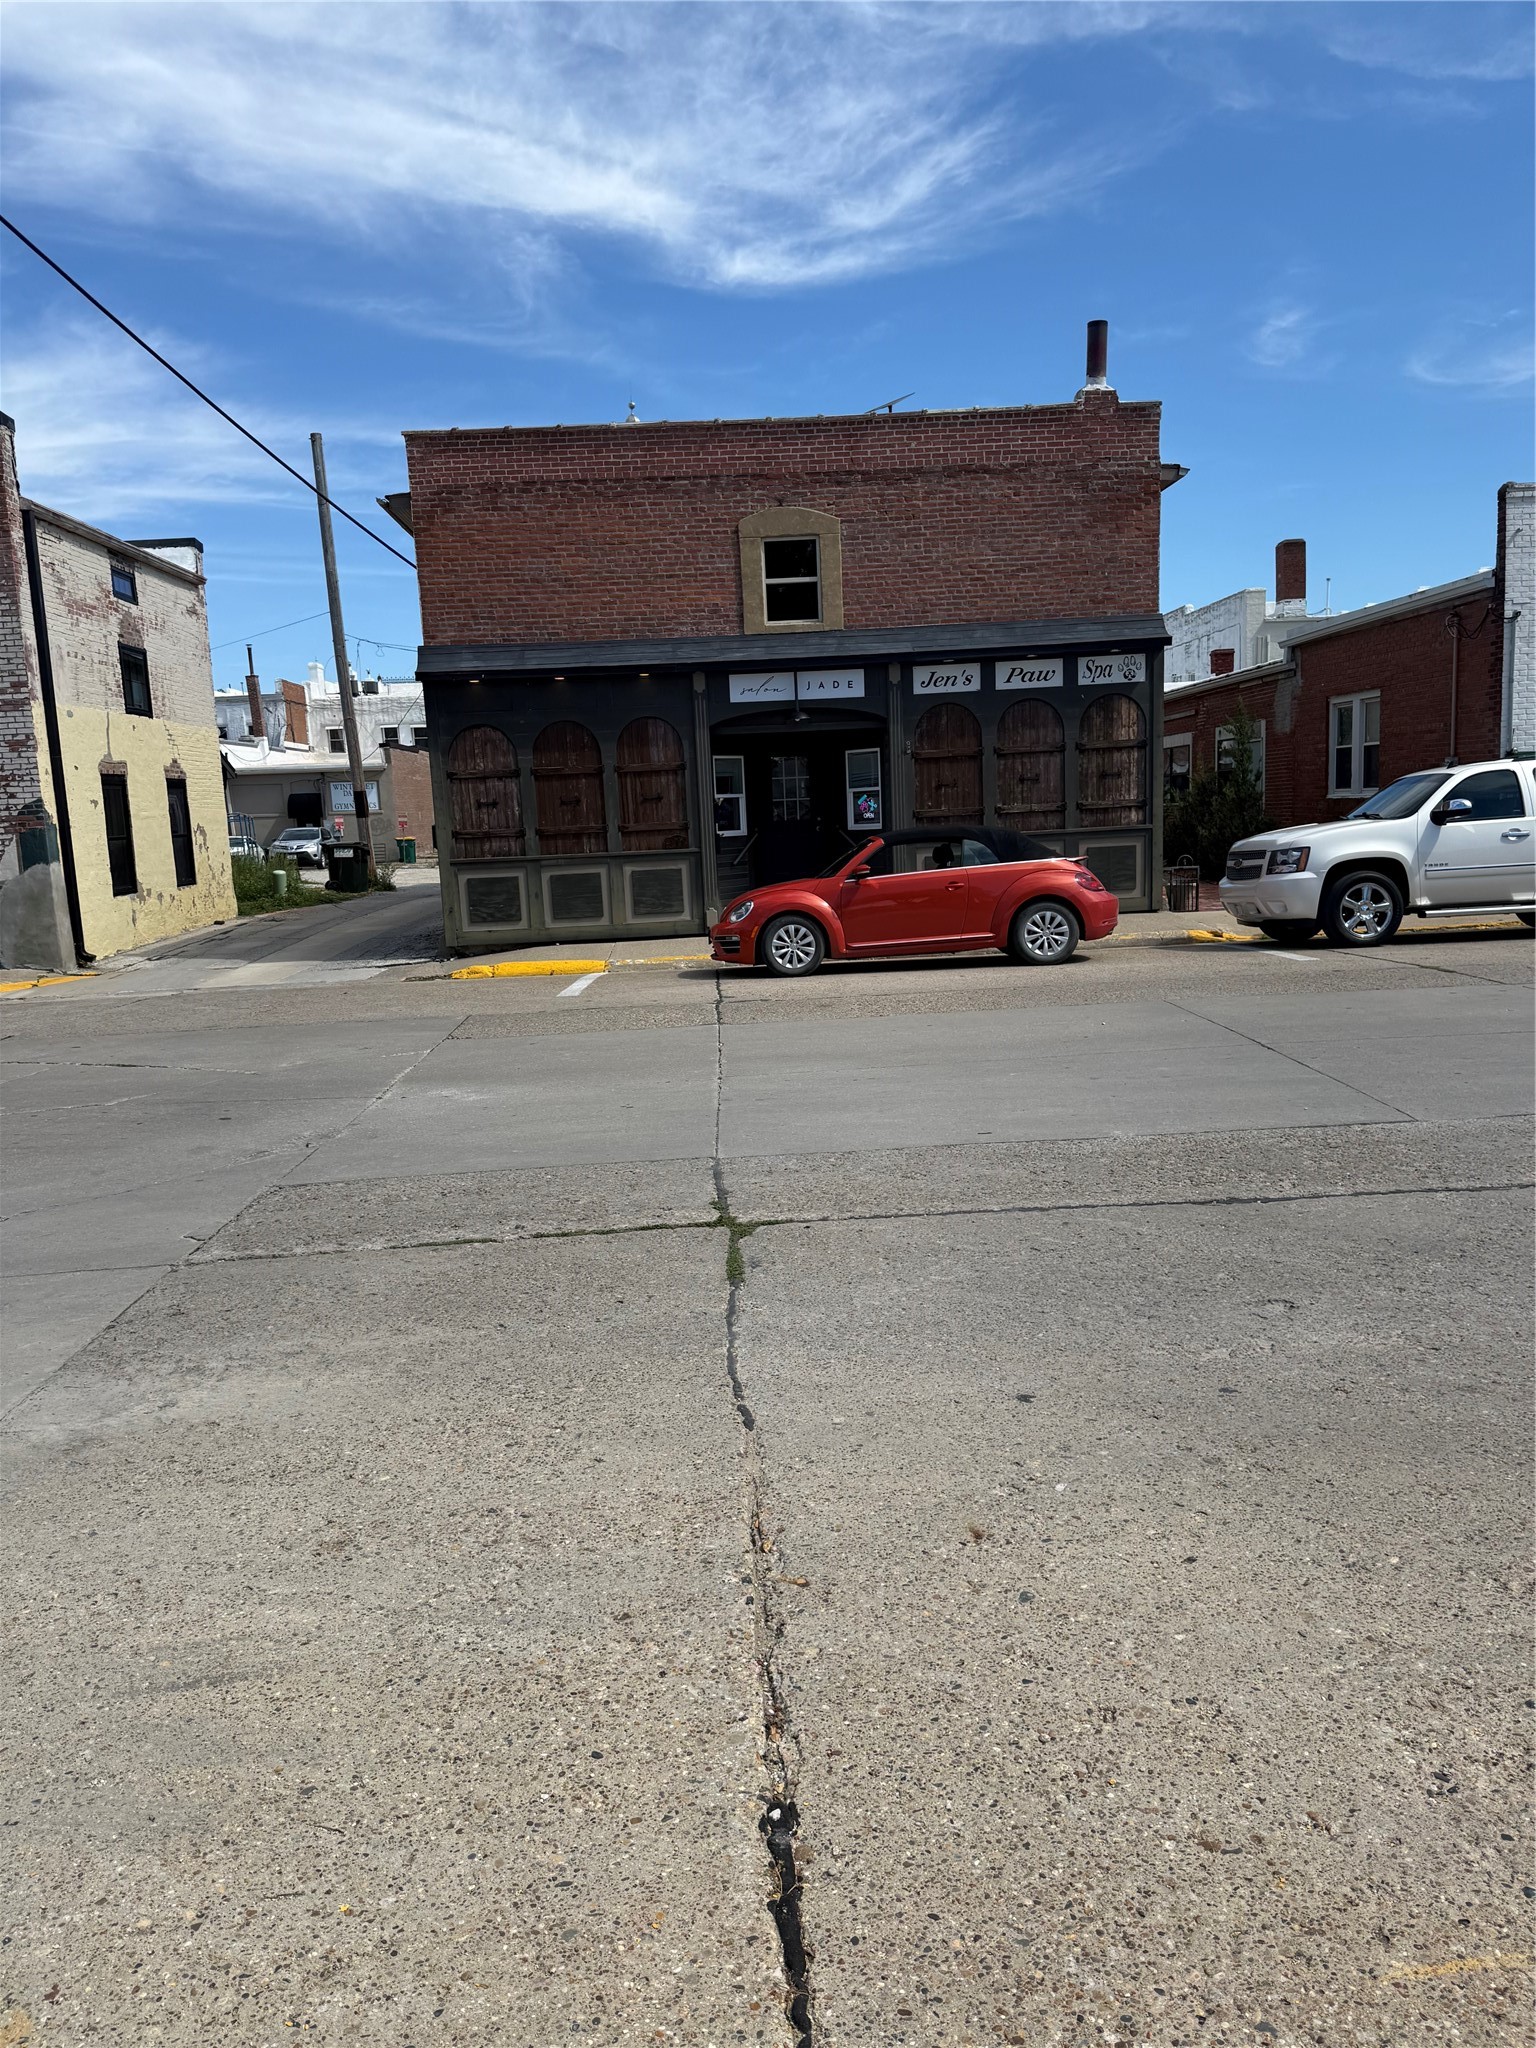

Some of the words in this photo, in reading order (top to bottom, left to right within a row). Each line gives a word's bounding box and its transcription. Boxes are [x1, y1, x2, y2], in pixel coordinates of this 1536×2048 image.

[740, 675, 788, 696] salon
[806, 680, 854, 691] JADE
[920, 669, 974, 688] Jen's
[1003, 666, 1057, 684] Paw
[1083, 659, 1113, 683] Spa
